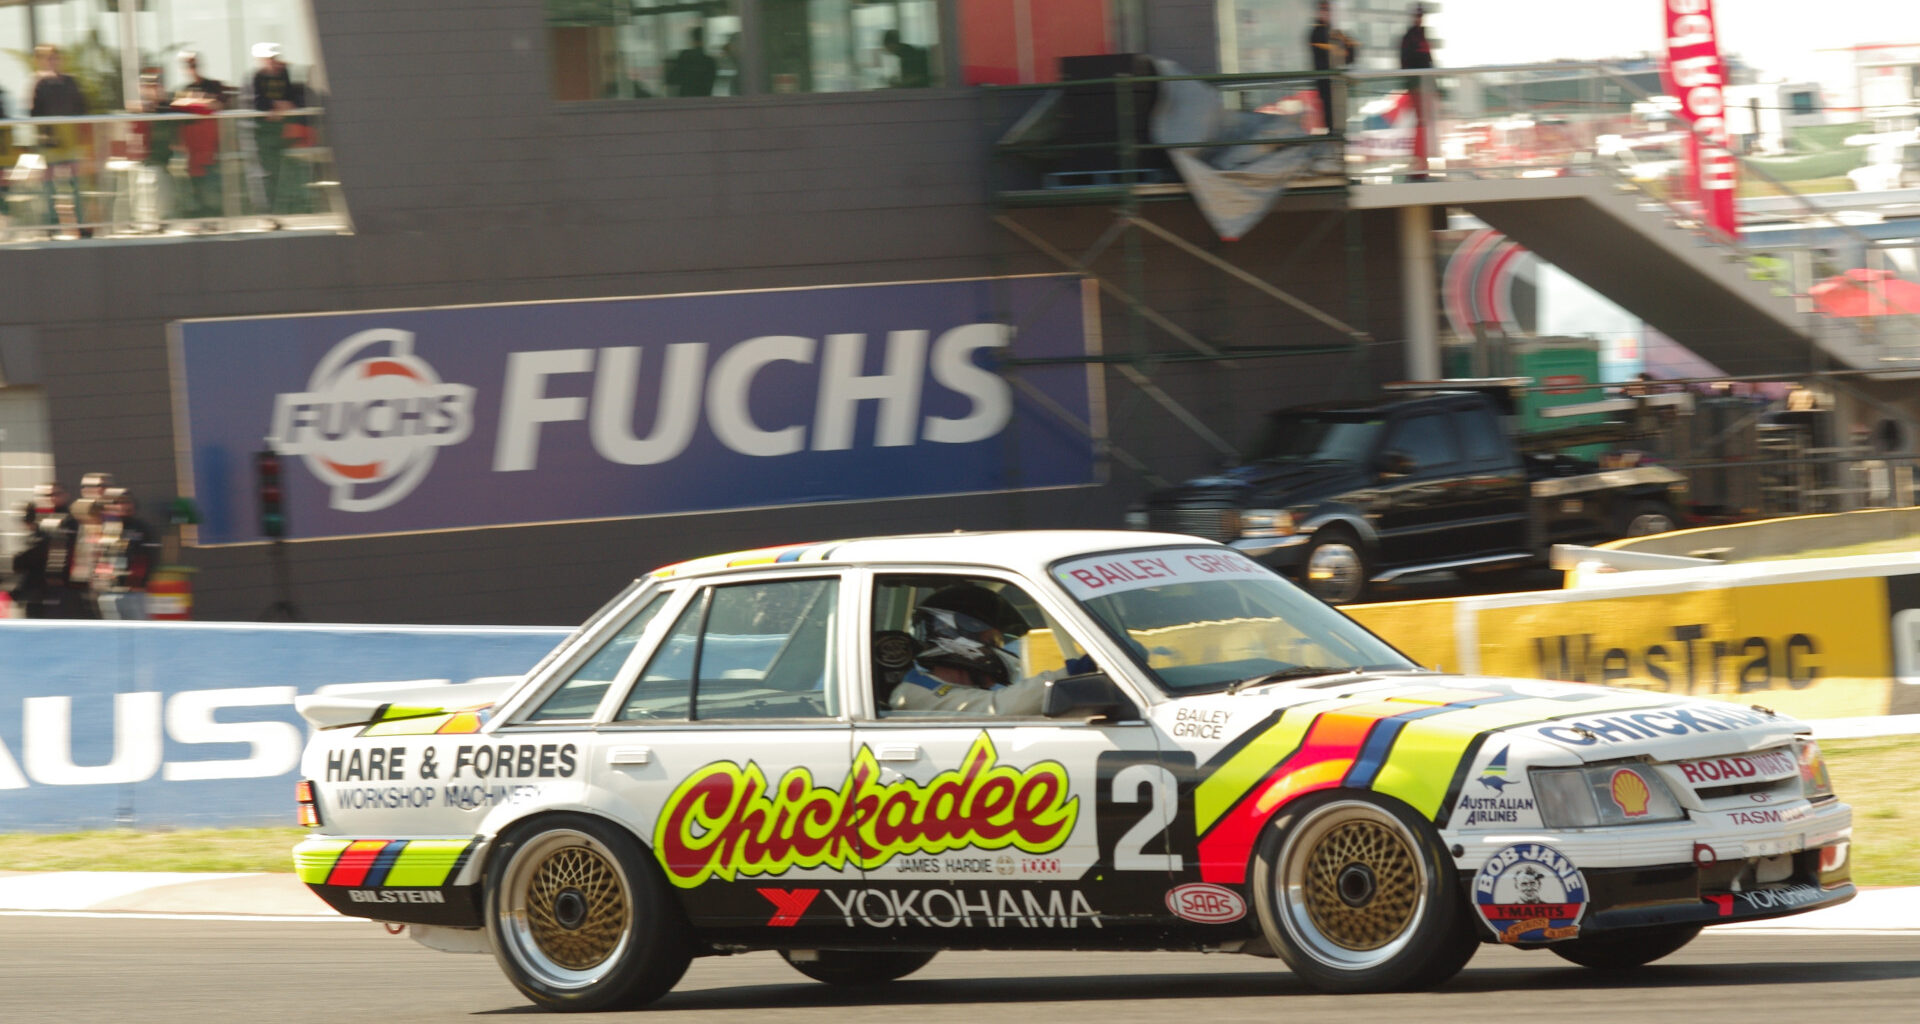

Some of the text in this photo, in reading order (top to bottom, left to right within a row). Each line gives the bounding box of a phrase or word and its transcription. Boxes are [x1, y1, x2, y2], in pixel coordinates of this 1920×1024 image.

[493, 323, 1014, 471] FUCHS
[288, 394, 458, 440] FUCHS
[1069, 557, 1178, 589] BAILEY
[1532, 624, 1823, 697] WesTrac
[1173, 722, 1223, 740] GRICE
[1176, 707, 1232, 724] BAILEY
[1537, 704, 1800, 746] CHICKAD
[0, 684, 303, 791] US
[327, 743, 578, 782] HARE & FORBES
[1678, 752, 1795, 783] ROADWAYS
[336, 787, 435, 809] WORKSHOP
[658, 738, 1074, 883] Chickadee
[1458, 795, 1534, 810] AUSTRALIAN
[1750, 792, 1773, 803] OF
[1111, 764, 1184, 871] 2
[1465, 811, 1518, 826] AIRLINES
[1727, 807, 1807, 825] TASM
[896, 858, 940, 873] JAMES
[945, 858, 993, 873] HARDIE
[1478, 844, 1582, 894] BOB JANE
[347, 890, 445, 904] BILSTEIN
[824, 889, 1104, 929] YOKOHAMA
[1180, 890, 1234, 917] SAAS
